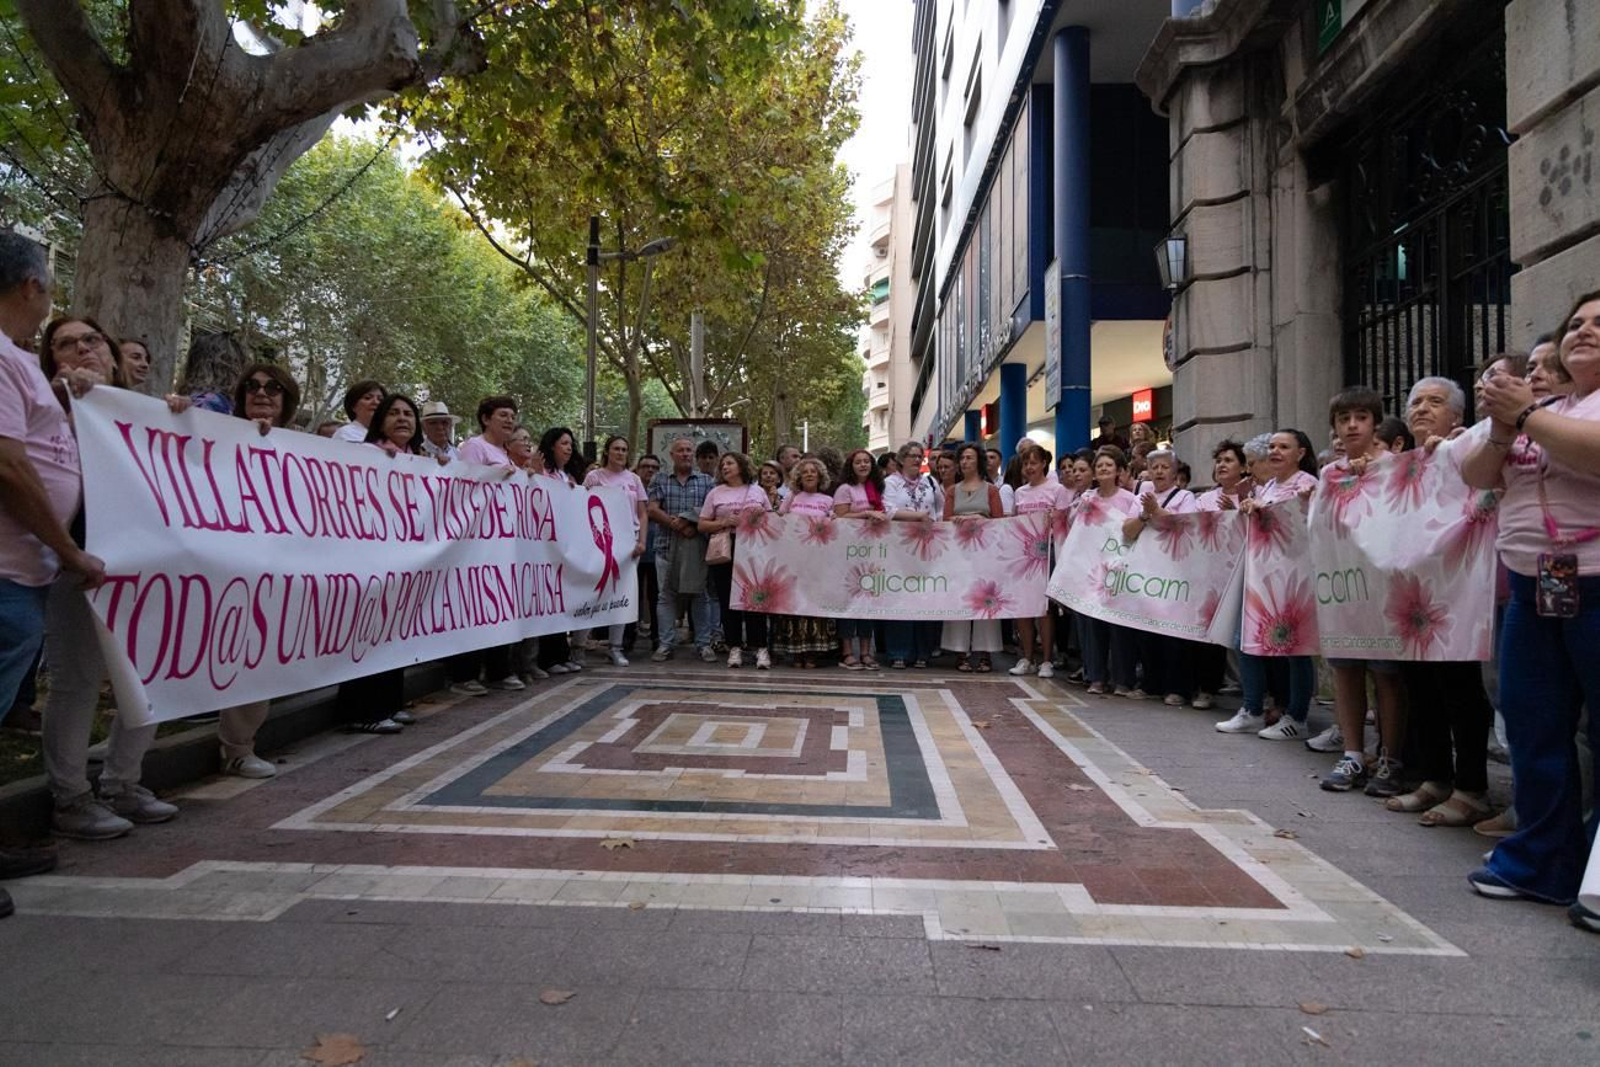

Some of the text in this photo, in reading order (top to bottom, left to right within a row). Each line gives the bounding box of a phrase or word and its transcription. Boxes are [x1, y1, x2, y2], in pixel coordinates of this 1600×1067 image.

[113, 419, 388, 542] VILLATORRES
[386, 469, 425, 542] SE
[419, 474, 481, 542] VISTE
[479, 482, 515, 540] DE
[846, 544, 873, 561] por
[859, 568, 948, 598] ajicam
[1104, 563, 1190, 602] ajicam
[1317, 567, 1369, 604] cam
[93, 571, 274, 691] TOD@S
[277, 571, 396, 664] UNID@S
[384, 570, 433, 644] POR
[430, 566, 458, 634] LA
[521, 562, 566, 619] CAUSA
